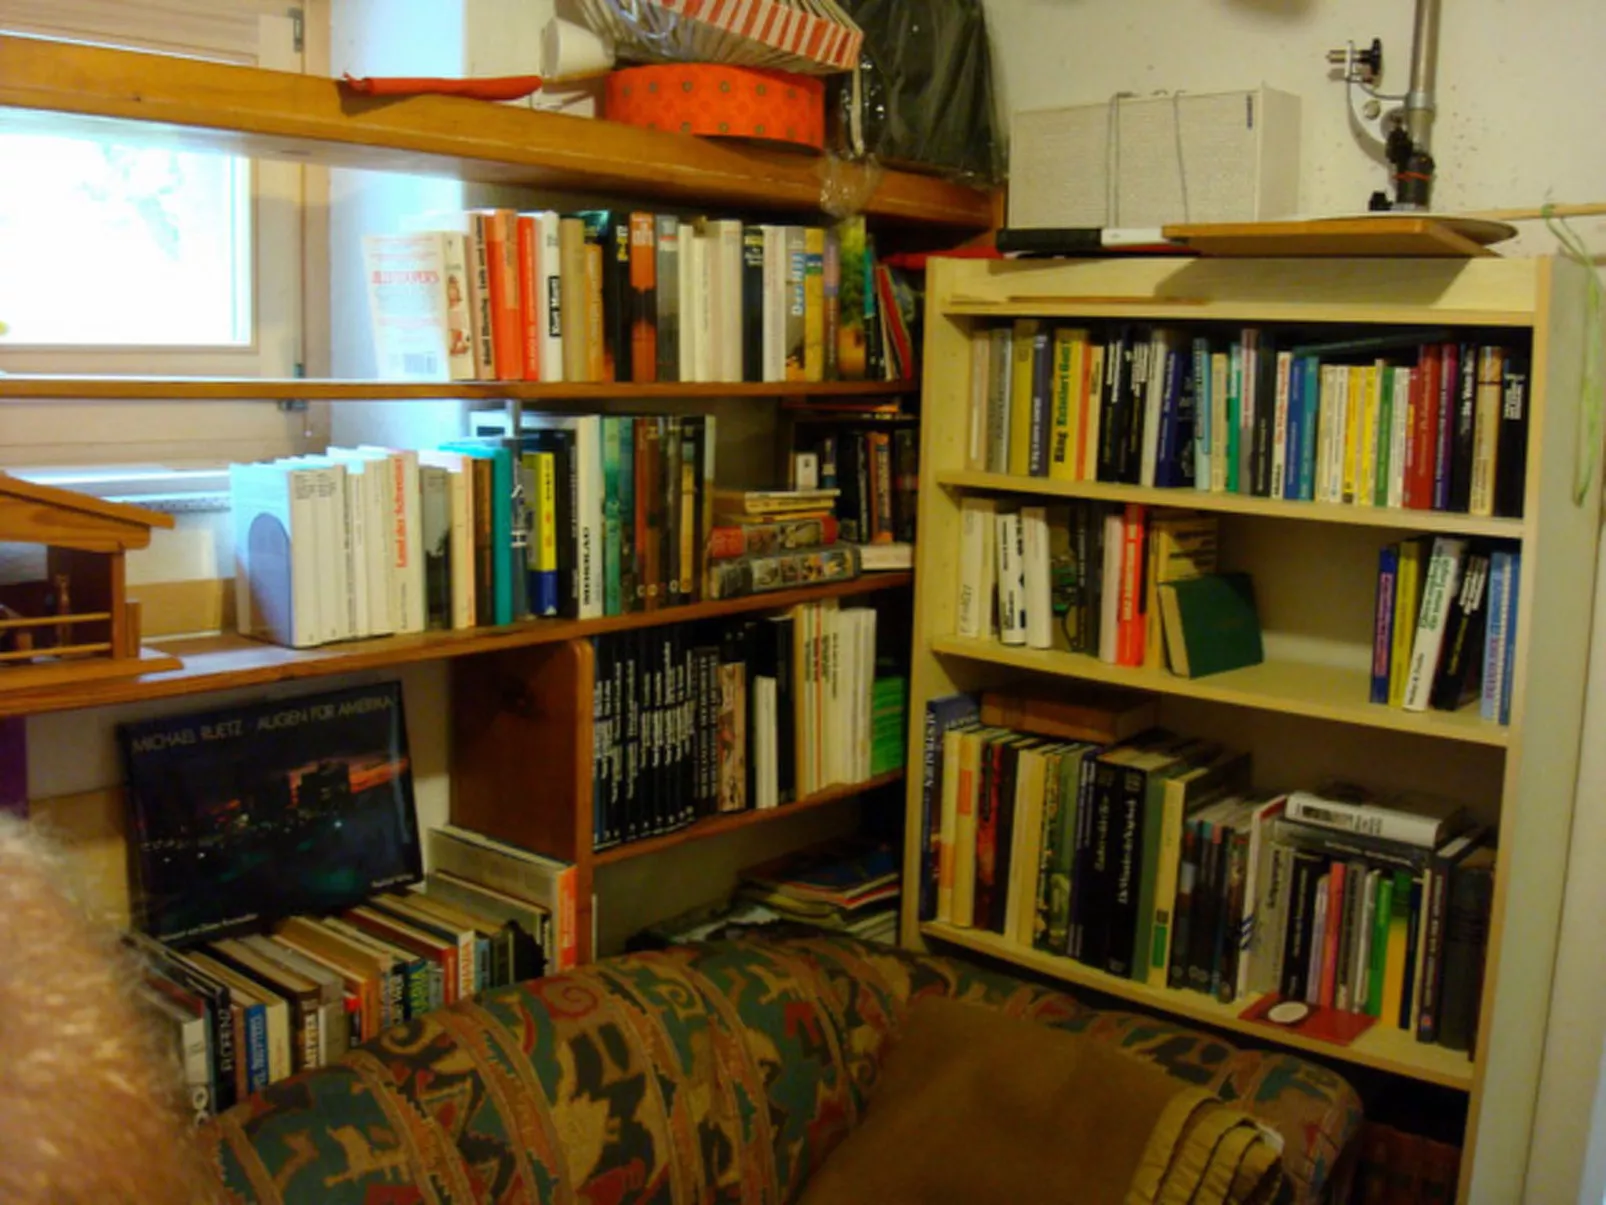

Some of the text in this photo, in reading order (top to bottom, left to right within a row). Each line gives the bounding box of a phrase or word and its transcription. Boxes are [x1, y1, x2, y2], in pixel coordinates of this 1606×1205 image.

[132, 728, 197, 755] MICHAEL
[257, 709, 310, 733] AUGEN
[338, 695, 395, 718] AMERIKA
